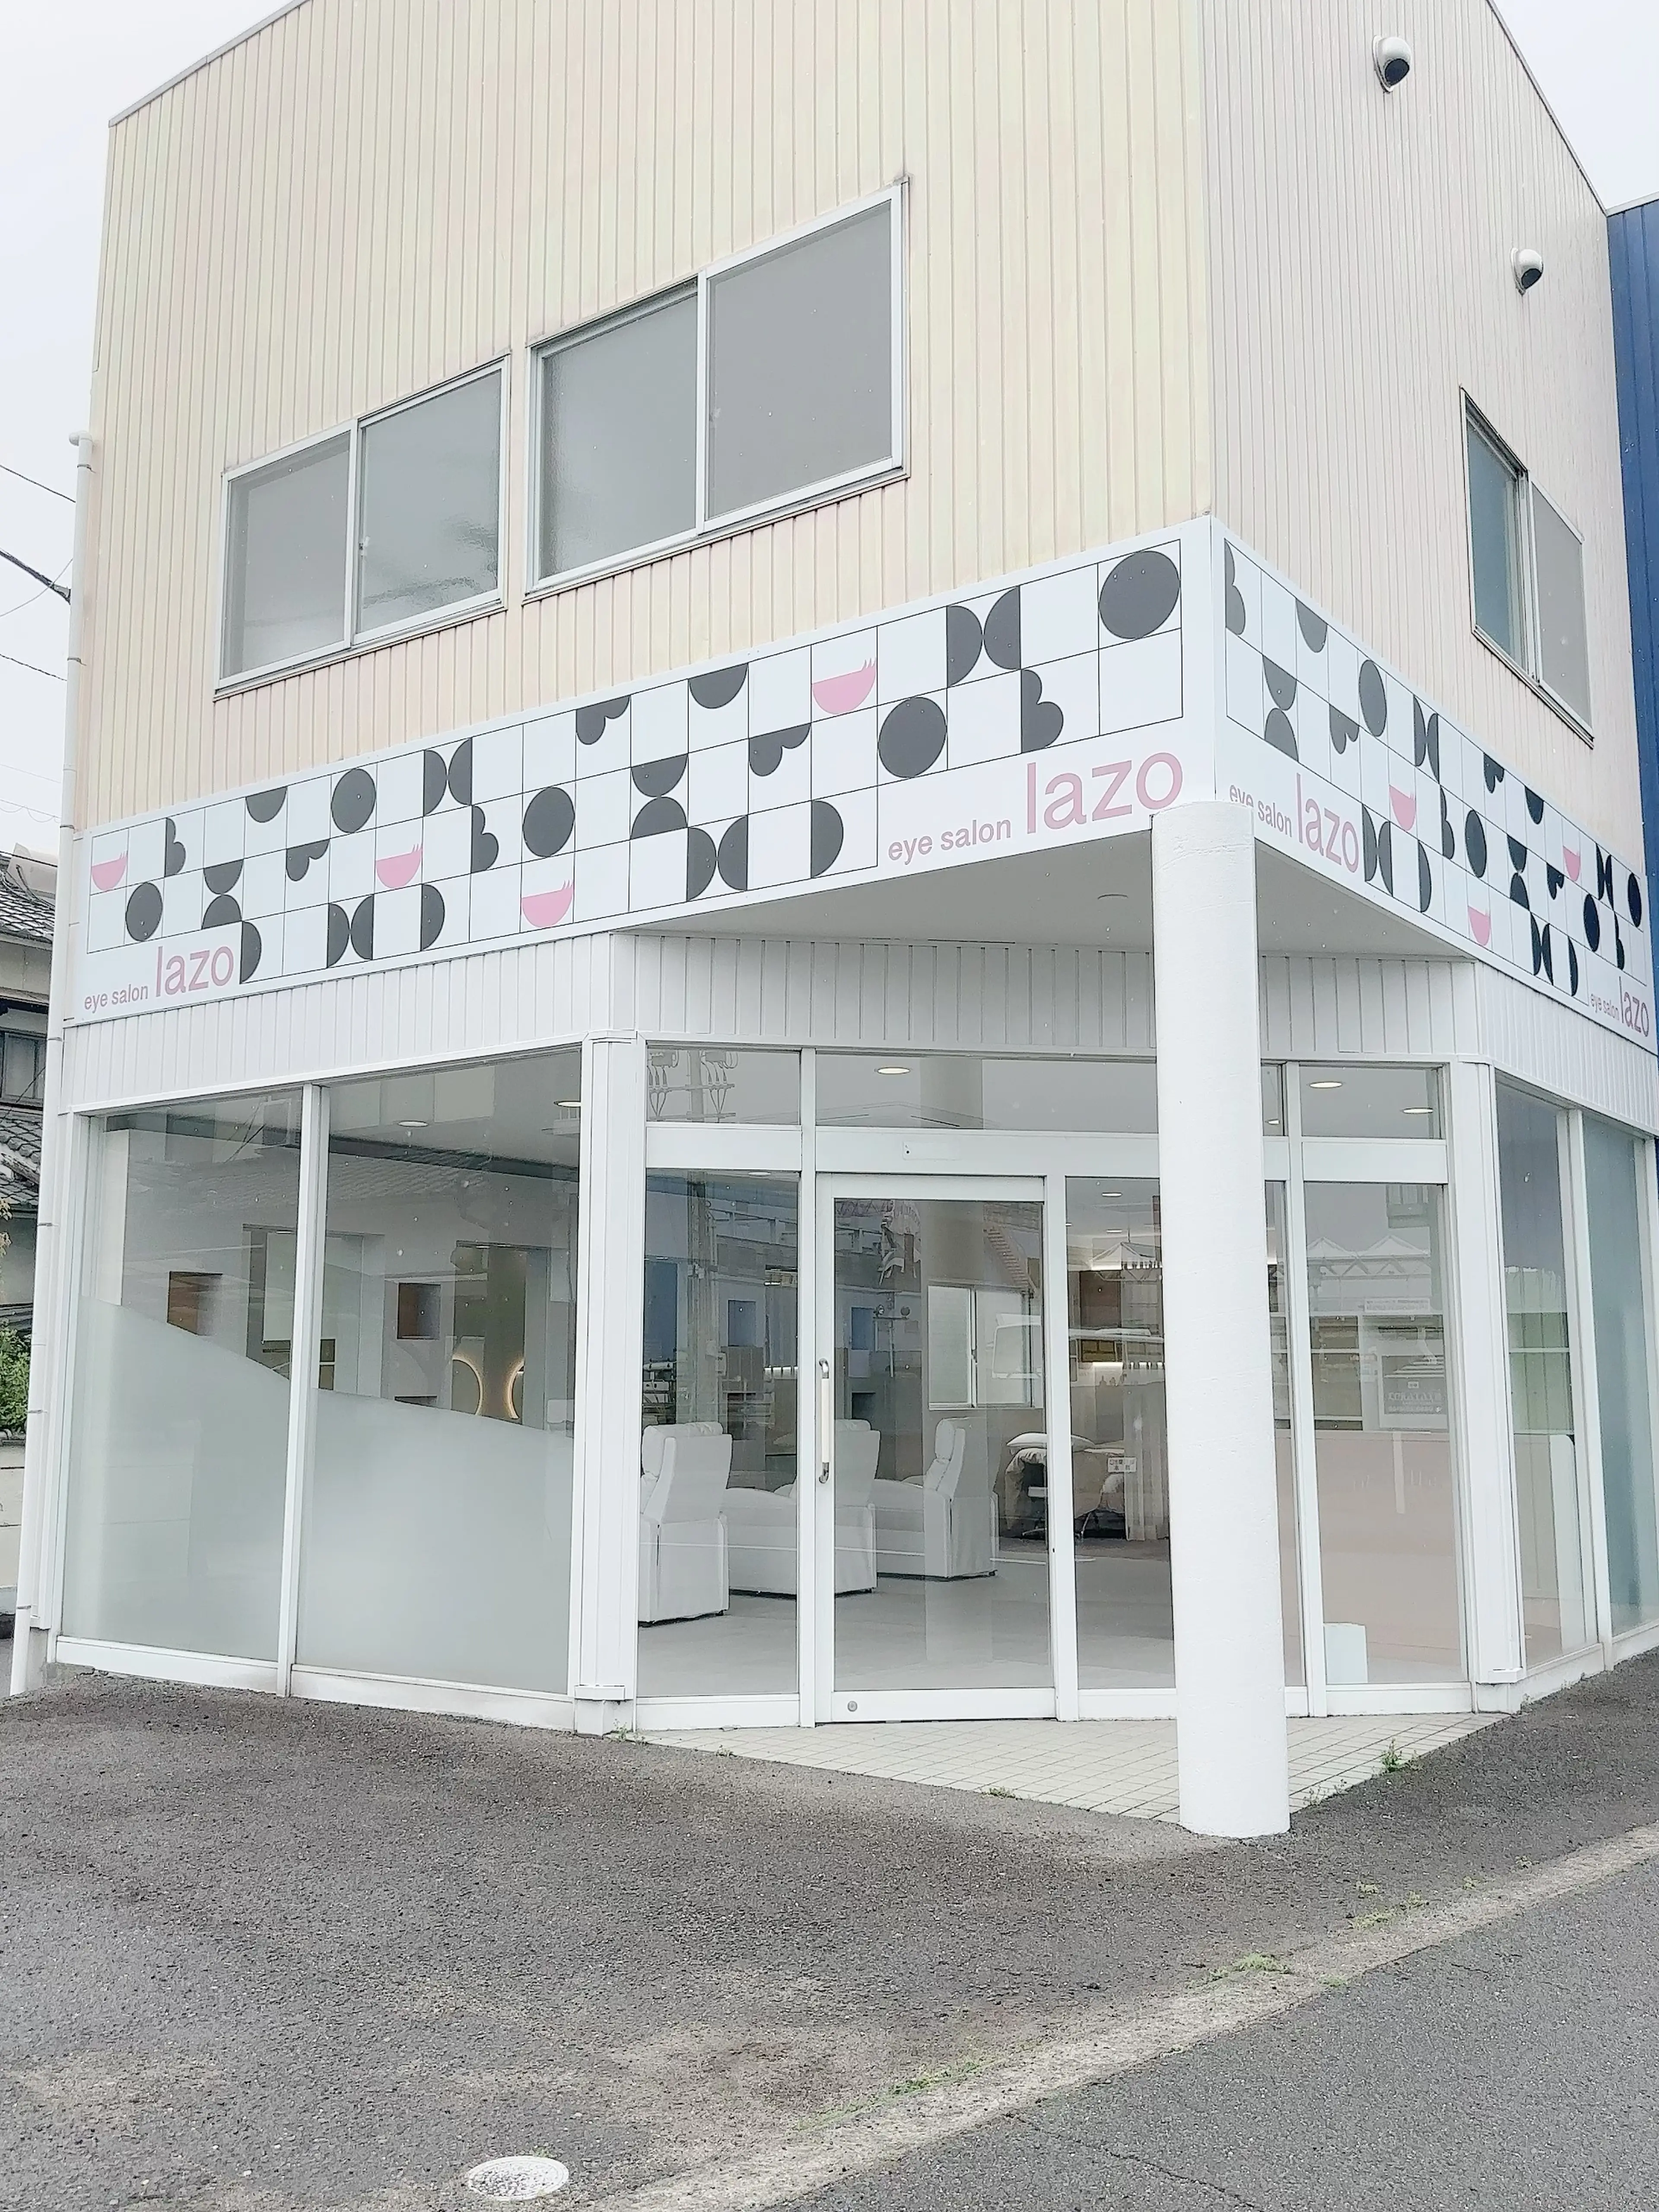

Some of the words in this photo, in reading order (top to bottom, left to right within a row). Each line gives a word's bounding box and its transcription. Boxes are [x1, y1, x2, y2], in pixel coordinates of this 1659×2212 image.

[888, 835, 932, 865] eye
[941, 819, 1011, 851] salon
[1027, 752, 1183, 834] lazo
[1258, 801, 1292, 838] salon
[1296, 772, 1359, 873] lazo
[84, 993, 108, 1014] eye
[111, 984, 149, 1004] salon
[155, 946, 234, 997] lazo
[1619, 976, 1649, 1037] lazo
